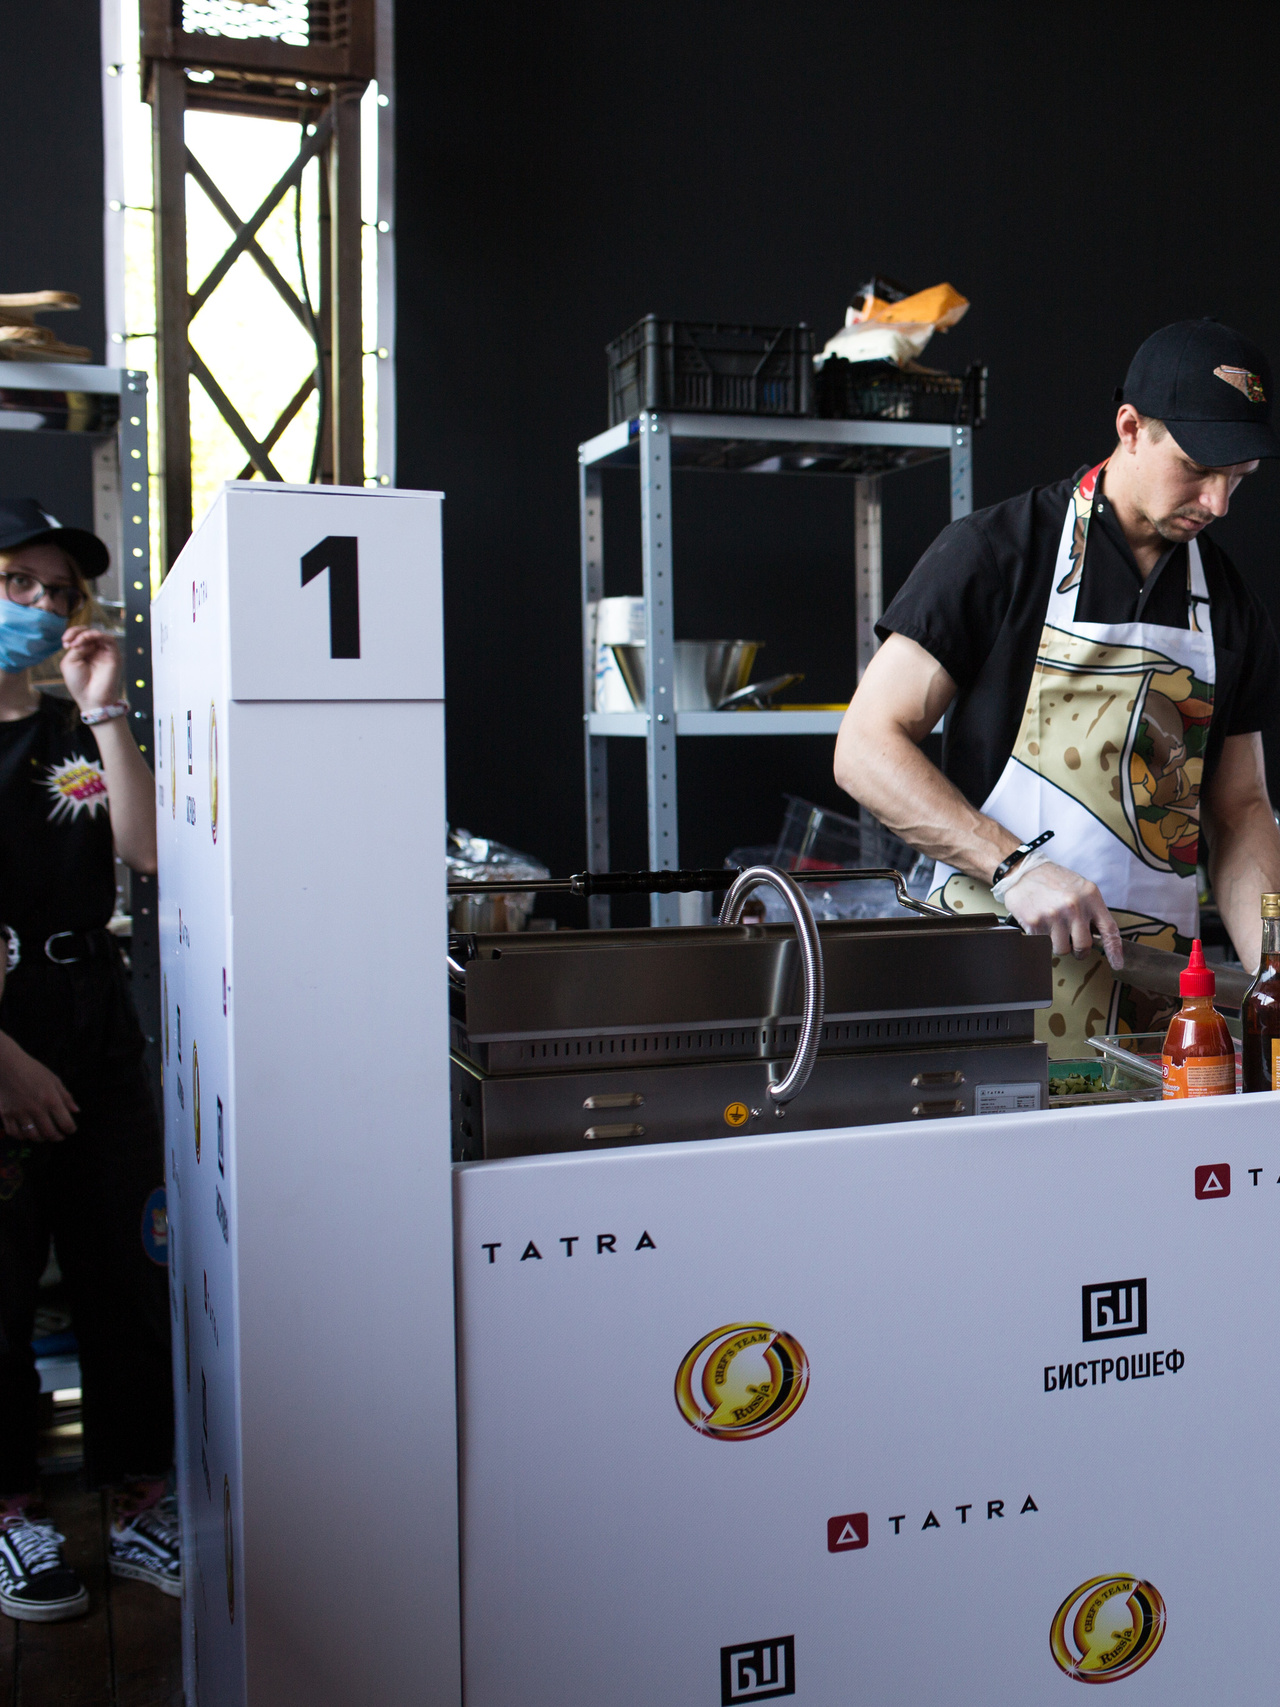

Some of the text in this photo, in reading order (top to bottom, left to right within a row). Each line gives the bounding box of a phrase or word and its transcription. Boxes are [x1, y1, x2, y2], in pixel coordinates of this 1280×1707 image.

[301, 535, 361, 660] 1
[482, 1231, 656, 1263] TATRA
[715, 1333, 767, 1385] CHEF'S TEAM
[1044, 1349, 1184, 1392] БИСТРОШЕФ
[889, 1495, 1038, 1534] TATRA
[1084, 1583, 1130, 1633] CHEF'S TEAM
